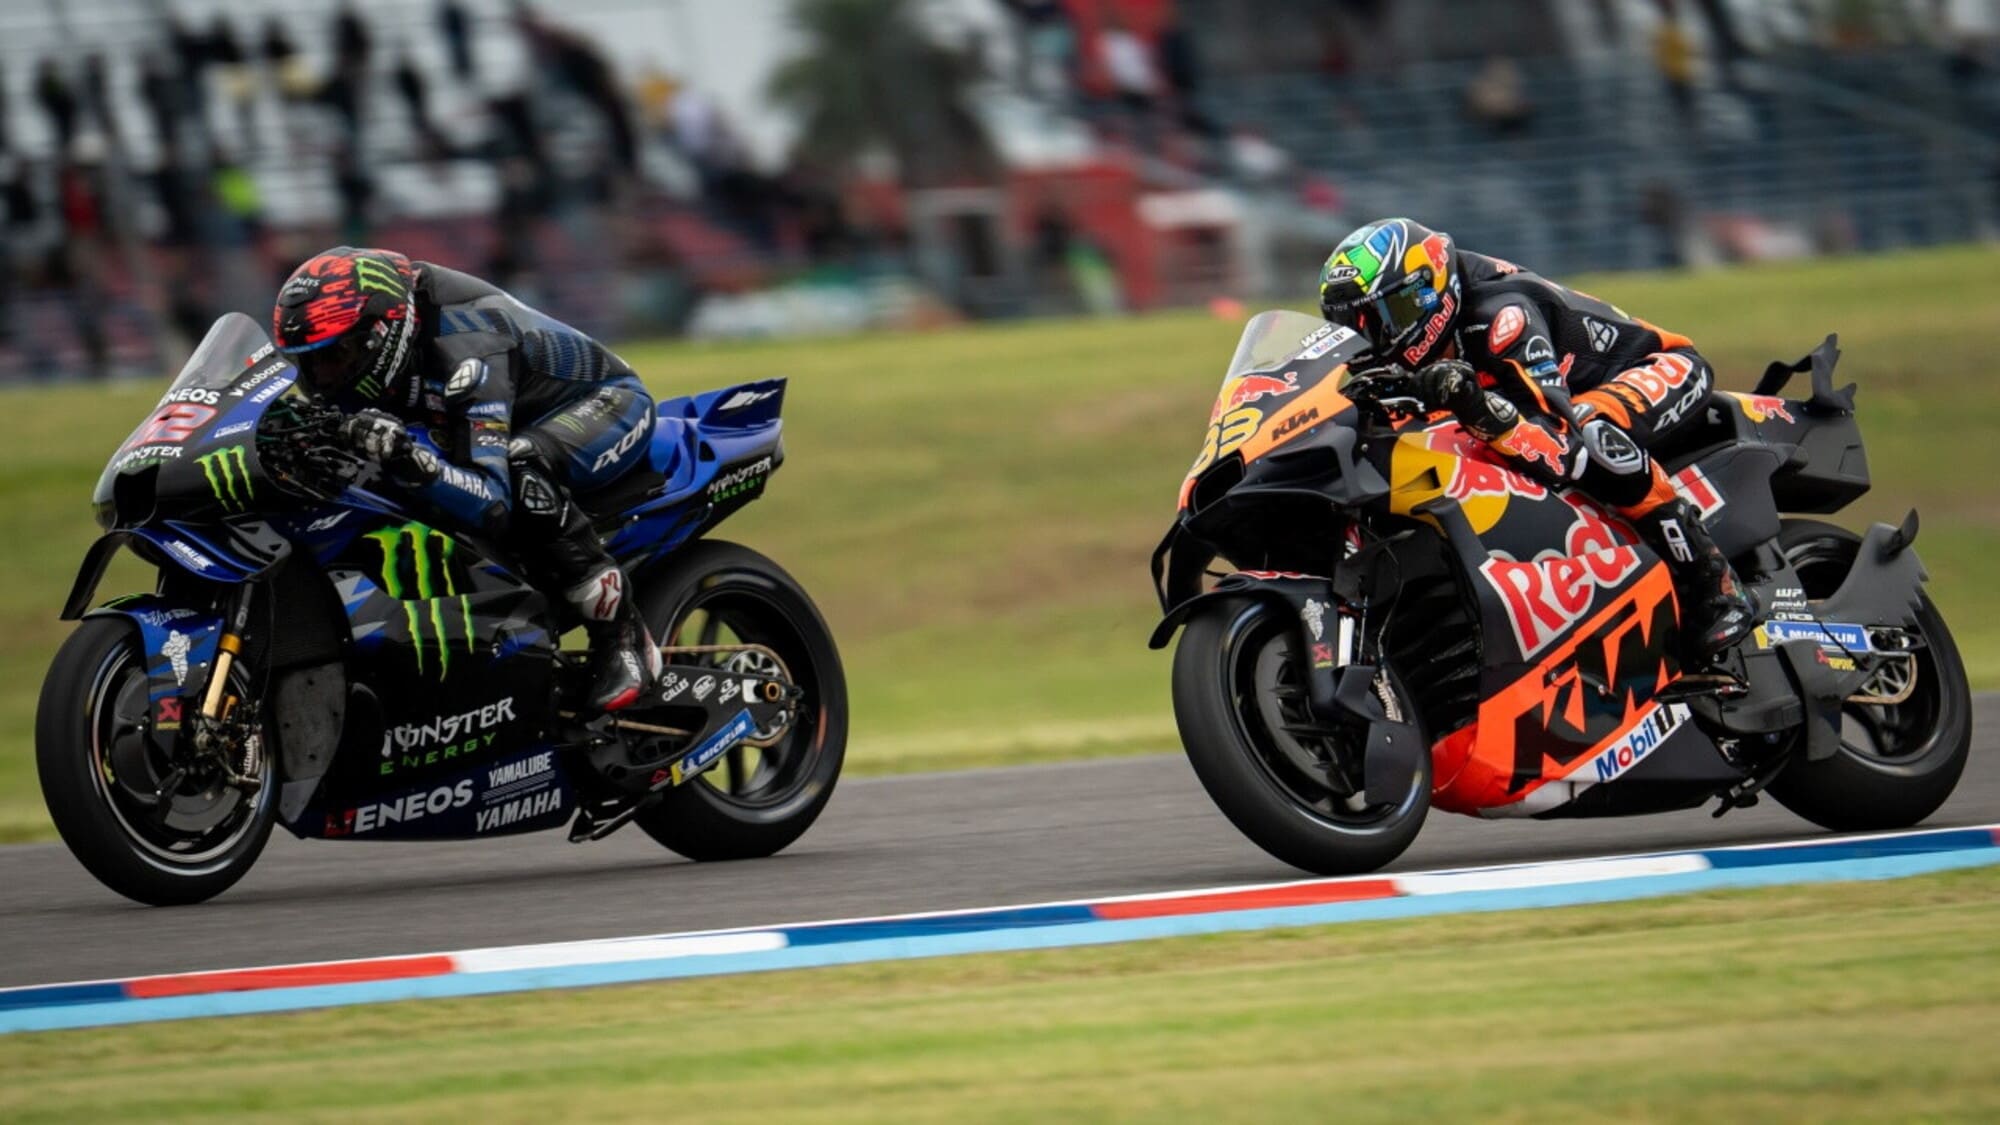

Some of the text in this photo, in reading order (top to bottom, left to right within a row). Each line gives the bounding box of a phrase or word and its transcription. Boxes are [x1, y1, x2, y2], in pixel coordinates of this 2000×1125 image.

[1301, 323, 1333, 348] WRS
[163, 388, 221, 405] NEOS
[241, 362, 287, 390] Roboze
[1653, 367, 1707, 433] IXON
[592, 408, 651, 473] IXON
[1272, 407, 1319, 441] KTM
[442, 464, 493, 500] AMAHA
[706, 456, 771, 495] MONSTER
[1480, 492, 1642, 662] Red
[1775, 588, 1803, 598] WP
[662, 677, 690, 702] GILLES
[1508, 592, 1682, 796] KTM
[380, 732, 497, 776] ENERGY
[698, 720, 746, 764] MICHELIN
[1596, 704, 1676, 783] Mobil 1
[488, 751, 555, 788] YAMALUBE
[354, 778, 474, 833] ENEOS
[475, 787, 562, 832] YAMAHA
